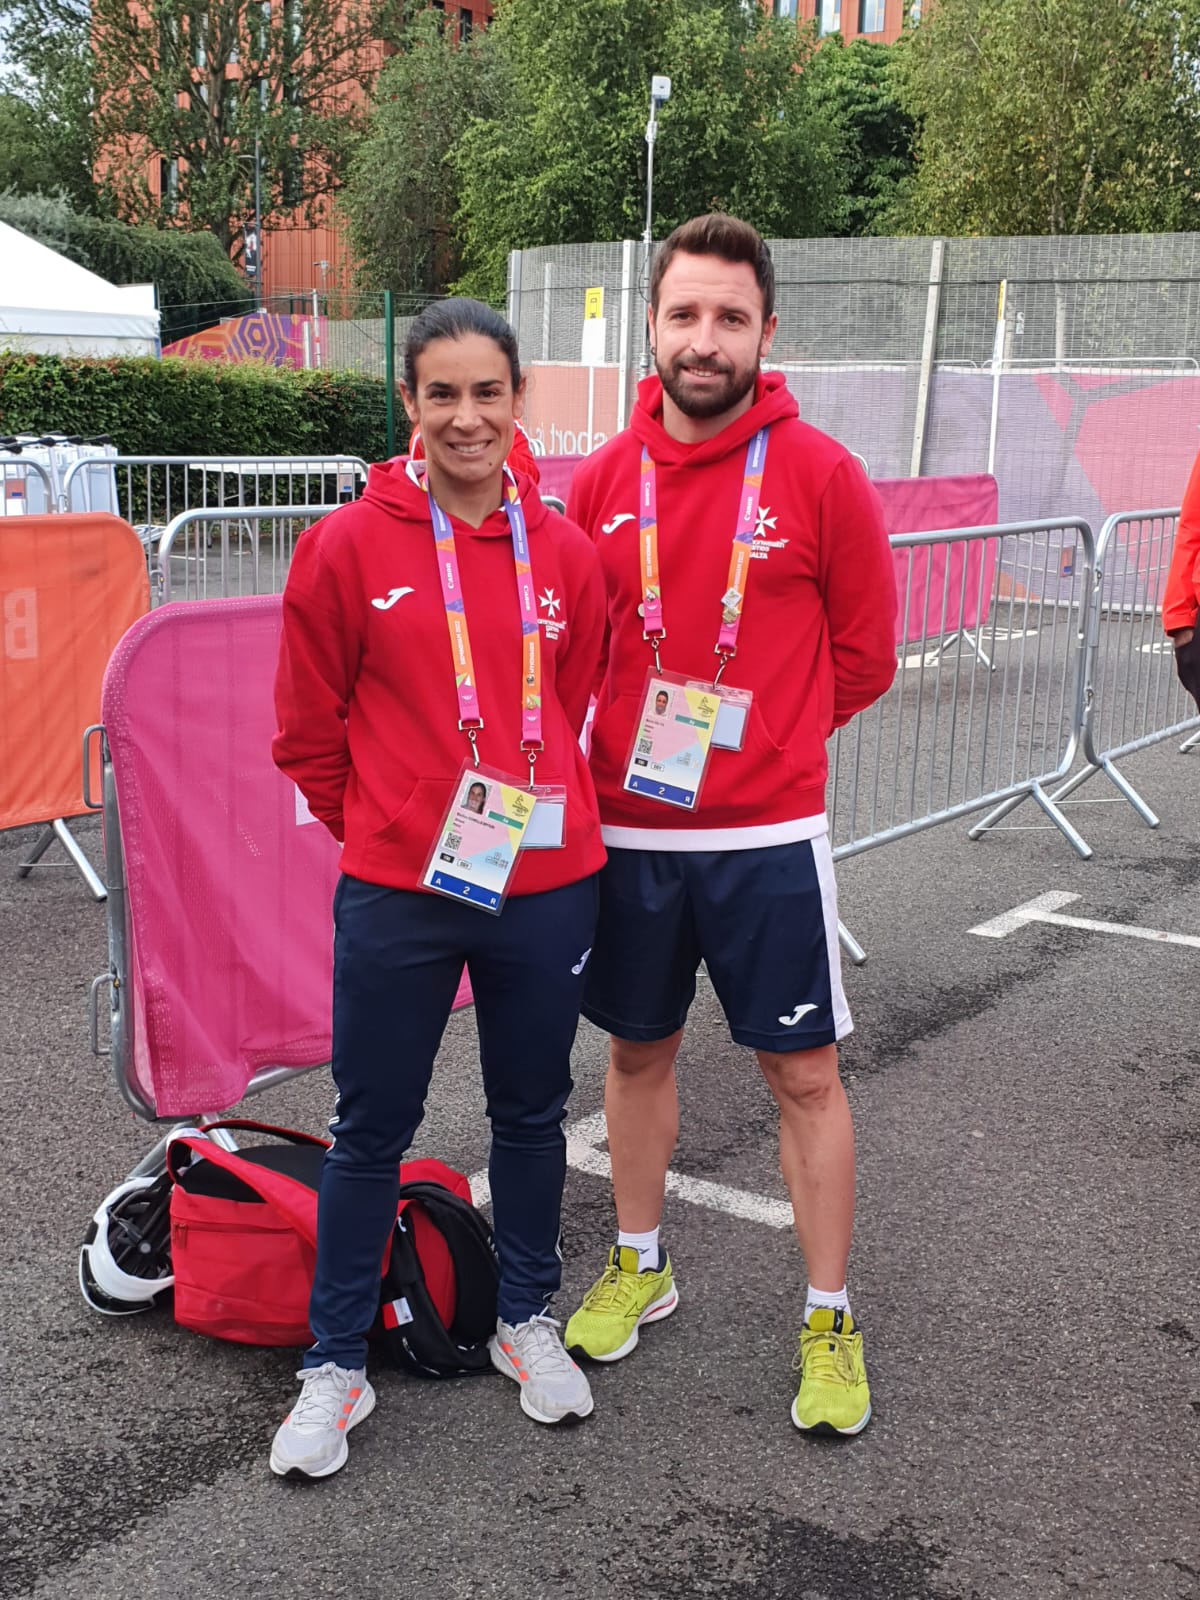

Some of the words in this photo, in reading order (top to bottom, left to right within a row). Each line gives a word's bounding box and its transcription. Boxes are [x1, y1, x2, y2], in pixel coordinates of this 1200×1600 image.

[445, 562, 454, 589] Canon
[631, 780, 639, 789] A
[657, 786, 666, 796] 2
[684, 795, 691, 803] R
[435, 877, 442, 886] A
[462, 886, 471, 895] 2
[490, 897, 497, 905] R
